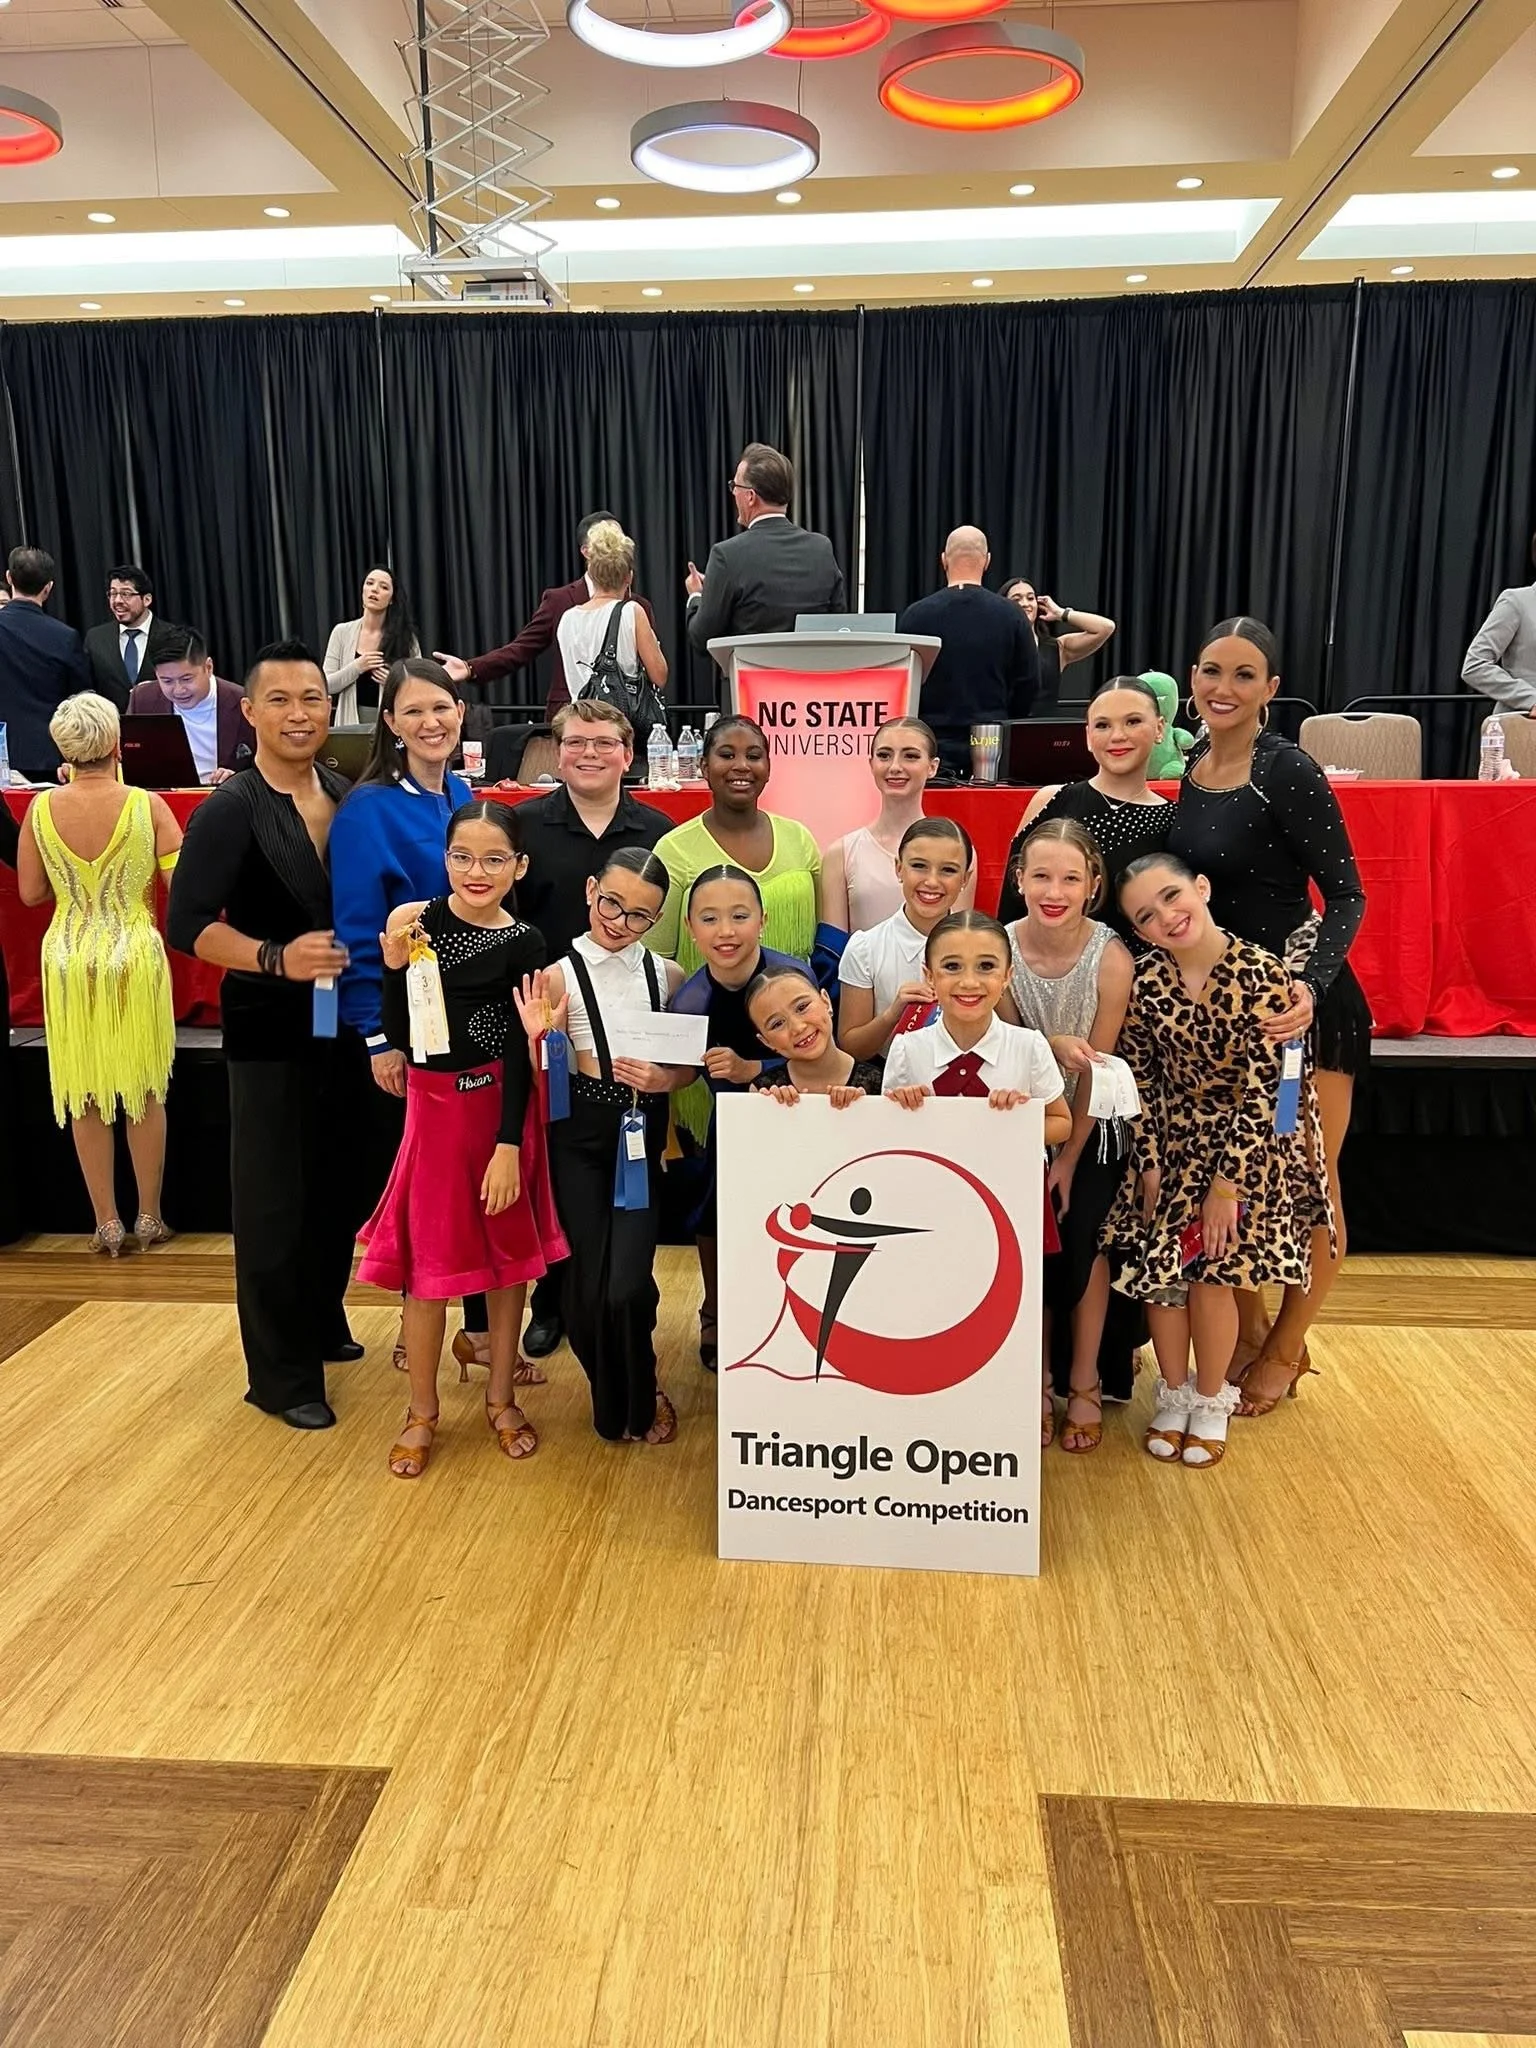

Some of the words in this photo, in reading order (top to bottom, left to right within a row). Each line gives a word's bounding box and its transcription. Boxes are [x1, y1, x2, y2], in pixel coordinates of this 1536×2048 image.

[758, 701, 797, 728] NC
[805, 701, 889, 728] STATE
[767, 733, 876, 756] NIVERSIT
[458, 1074, 493, 1091] Hsian
[731, 1431, 893, 1480] Triangle
[905, 1439, 1019, 1485] Open
[727, 1488, 867, 1519] Dancesport
[873, 1495, 1029, 1525] Competition
